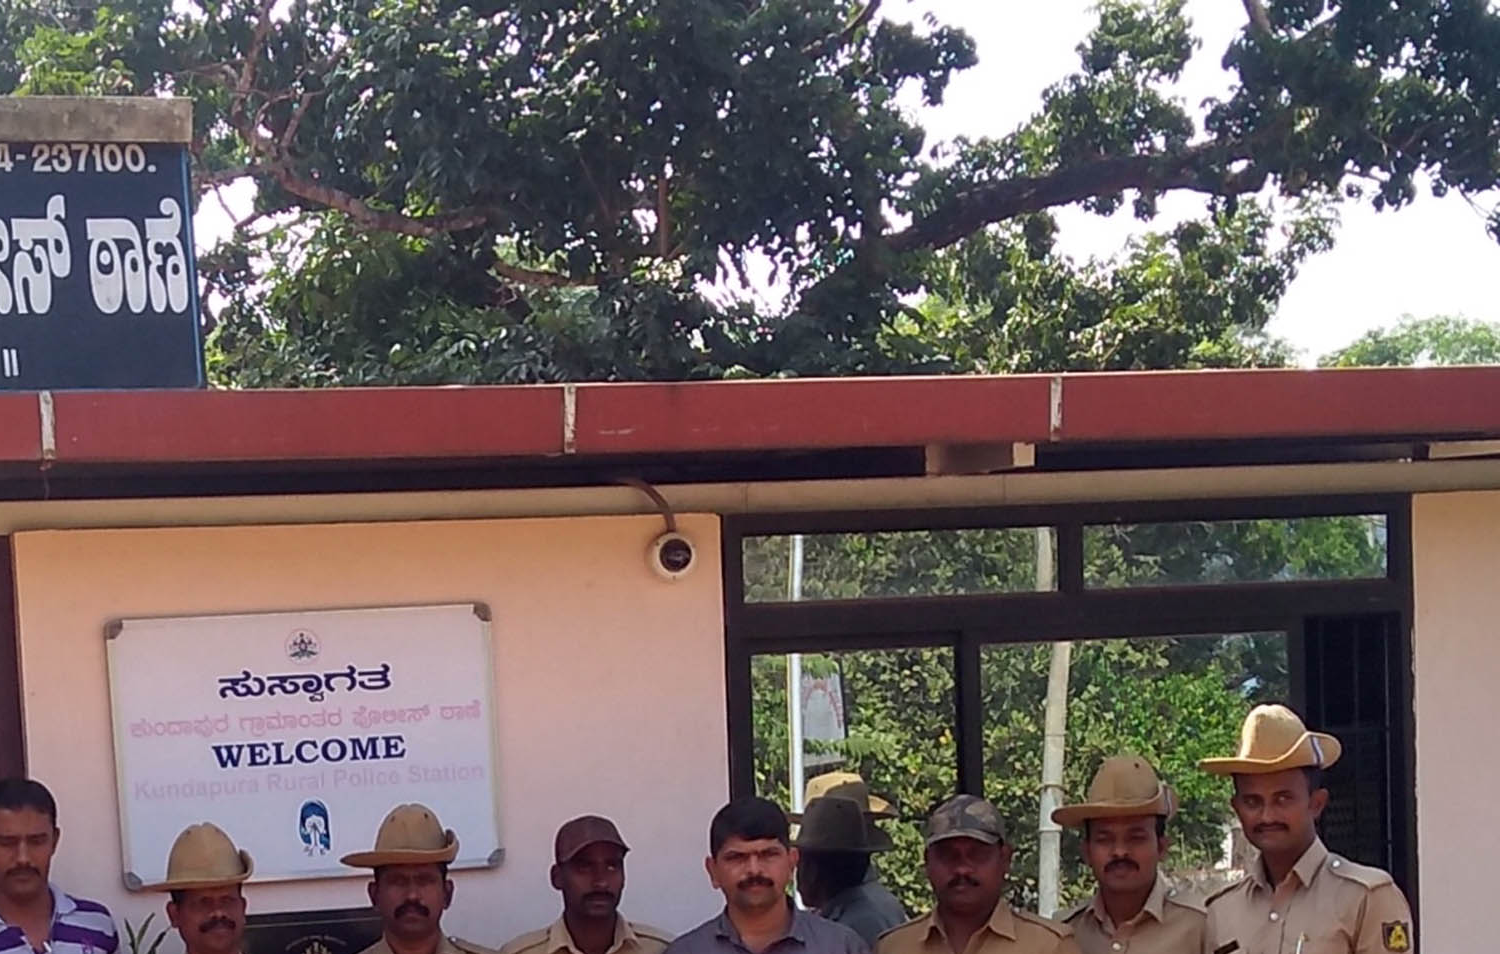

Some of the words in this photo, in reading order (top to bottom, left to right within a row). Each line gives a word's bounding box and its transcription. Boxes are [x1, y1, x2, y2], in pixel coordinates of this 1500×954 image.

[86, 197, 189, 314] ಠಾಣೆ
[217, 663, 392, 703] ಸುಸ್ವಾಗತ
[211, 735, 407, 769] WELCOME
[134, 778, 260, 801] Kundapura
[267, 771, 325, 791] Rural
[333, 767, 400, 789] Police
[407, 763, 485, 784] Station
